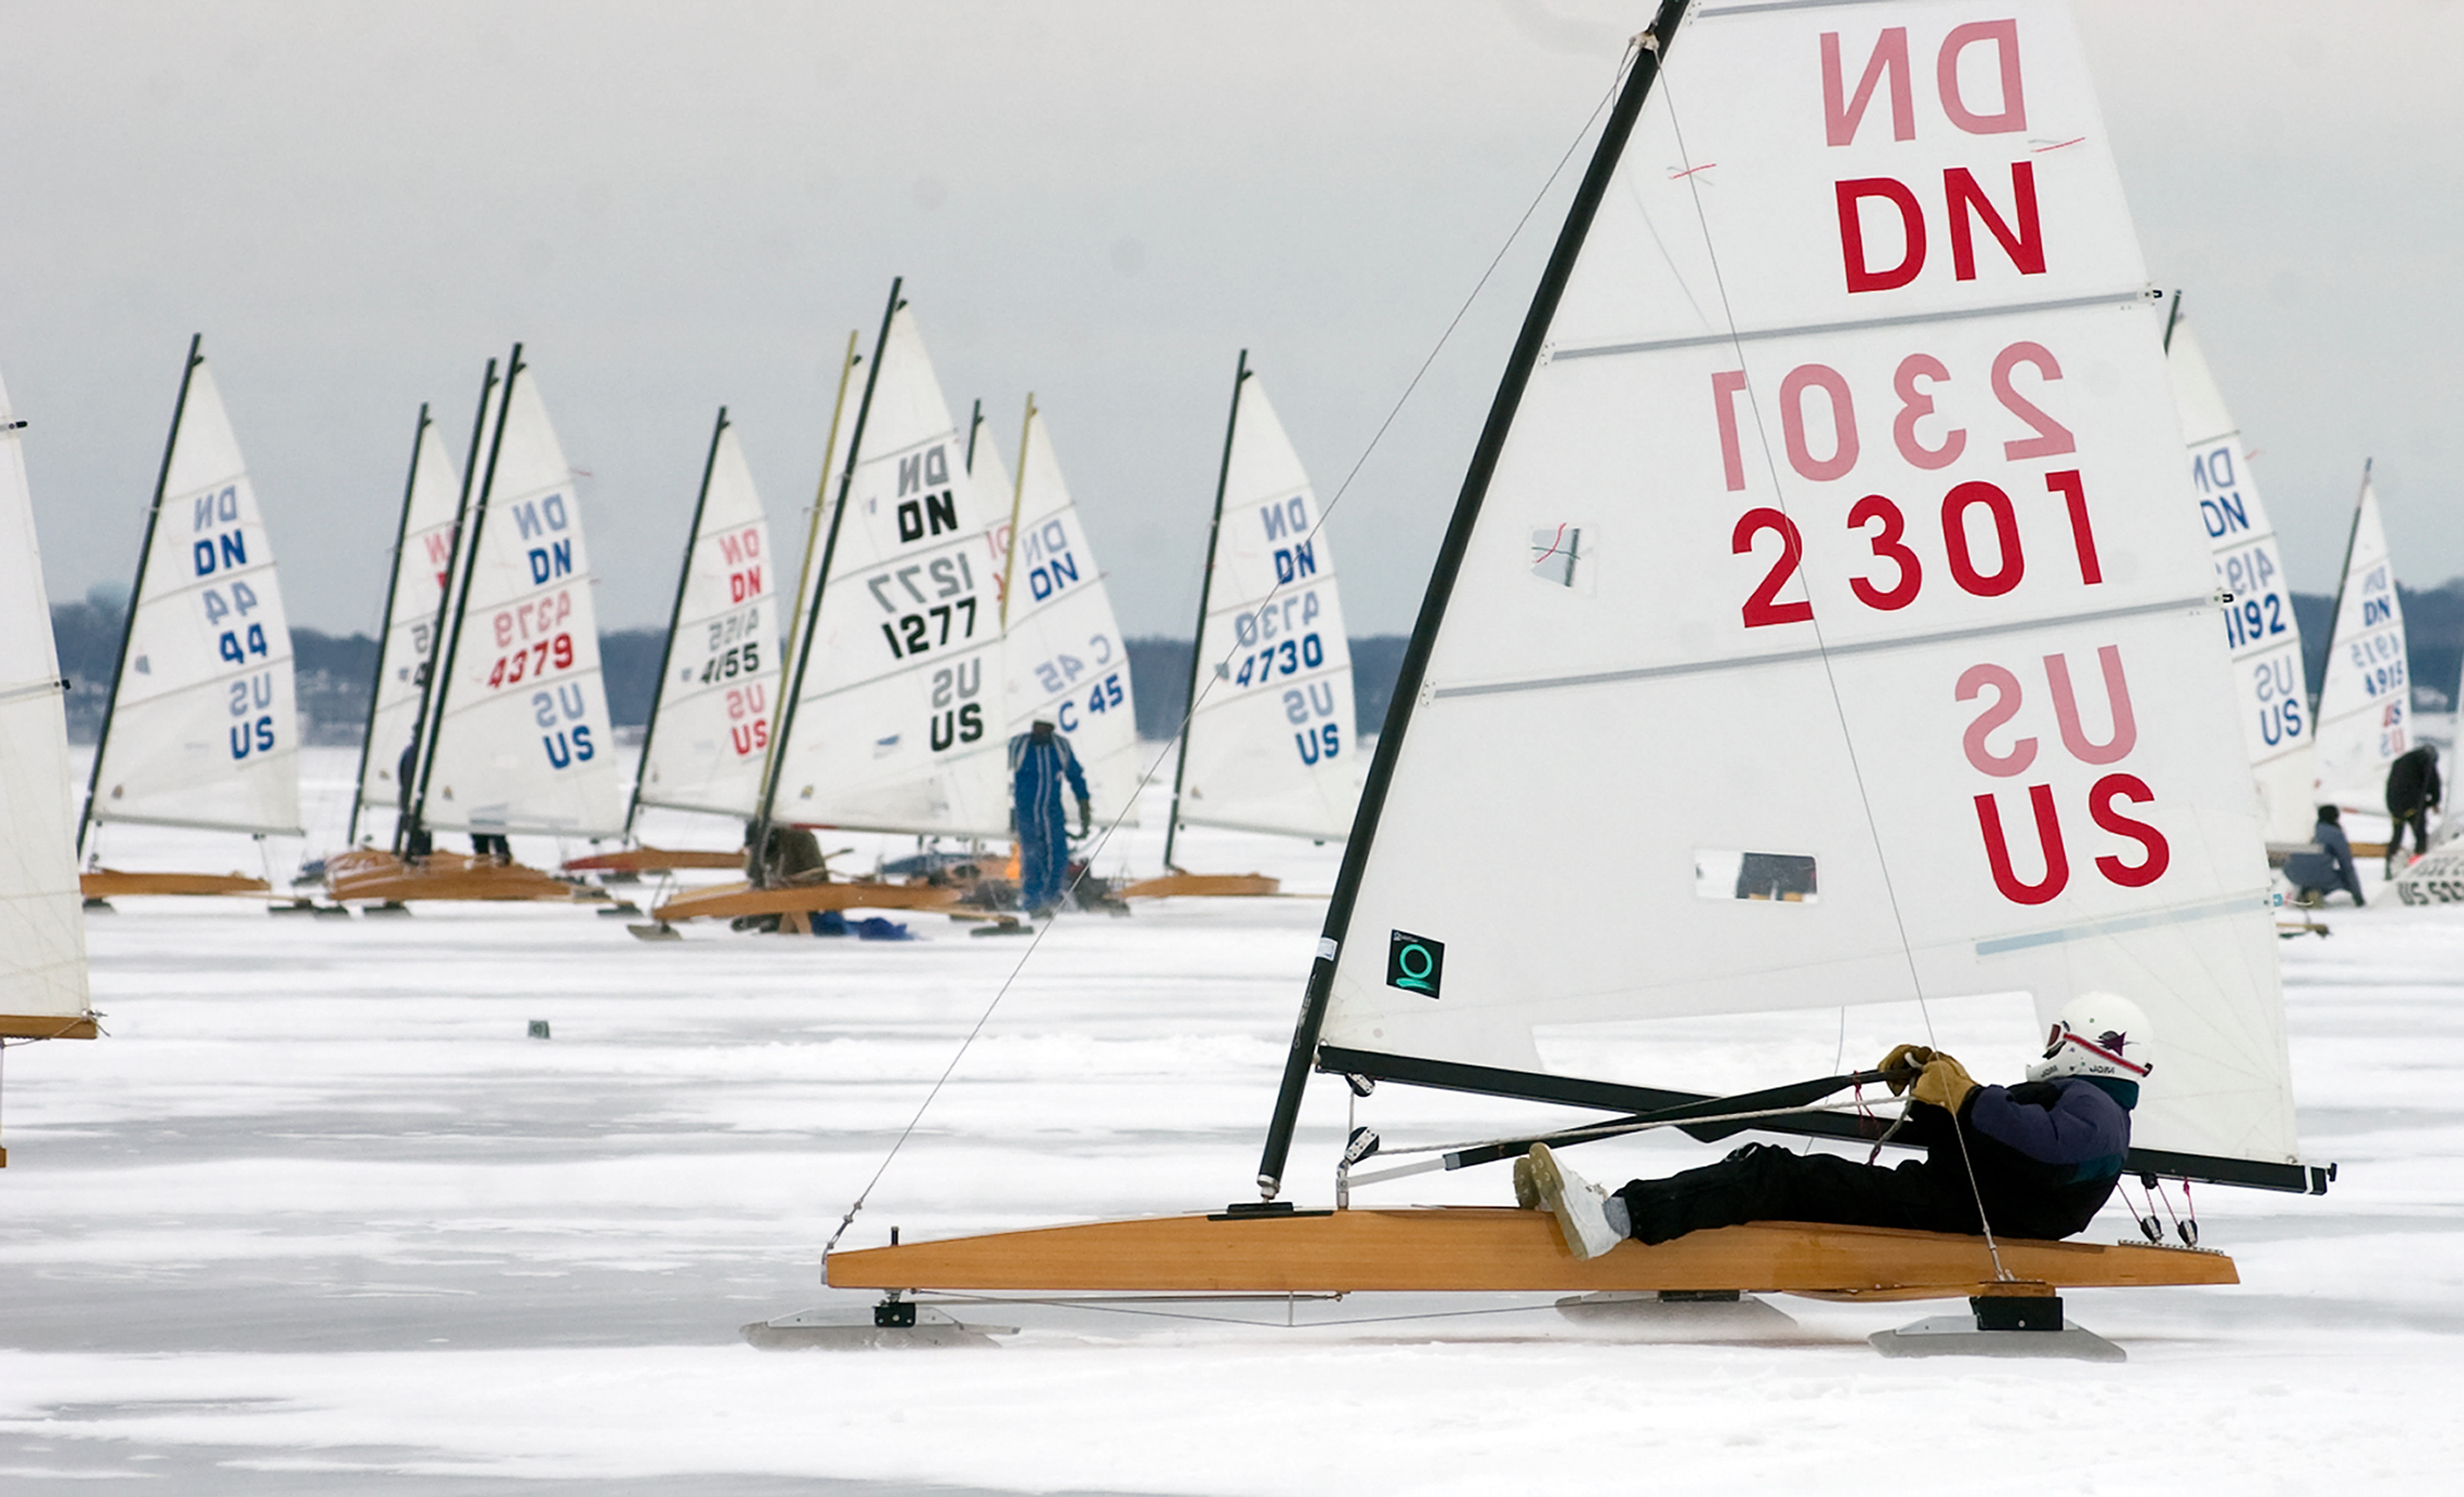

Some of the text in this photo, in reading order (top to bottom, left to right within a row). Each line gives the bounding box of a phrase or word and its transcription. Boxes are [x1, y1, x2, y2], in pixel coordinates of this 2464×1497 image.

[1835, 161, 2046, 293] DN
[898, 489, 958, 543] DN
[2200, 492, 2250, 538] DN
[194, 529, 247, 577] DN
[527, 539, 572, 586] DN
[1273, 539, 1316, 585] DN
[1732, 469, 2103, 628] 2301
[730, 566, 761, 604] DN
[1029, 552, 1079, 601] DN
[881, 596, 977, 660] 1277
[2363, 594, 2391, 627] DN
[218, 623, 268, 664] 44
[488, 632, 574, 690] 4379
[698, 642, 760, 685] 4155
[1236, 633, 1324, 687] 4730
[930, 702, 984, 752] US
[1058, 674, 1125, 733] C 45
[2260, 699, 2302, 746] US
[231, 715, 275, 761] US
[543, 725, 595, 770] US
[731, 719, 769, 756] US
[1295, 722, 1340, 766] US
[1974, 773, 2170, 905] US
[2398, 881, 2430, 907] US
